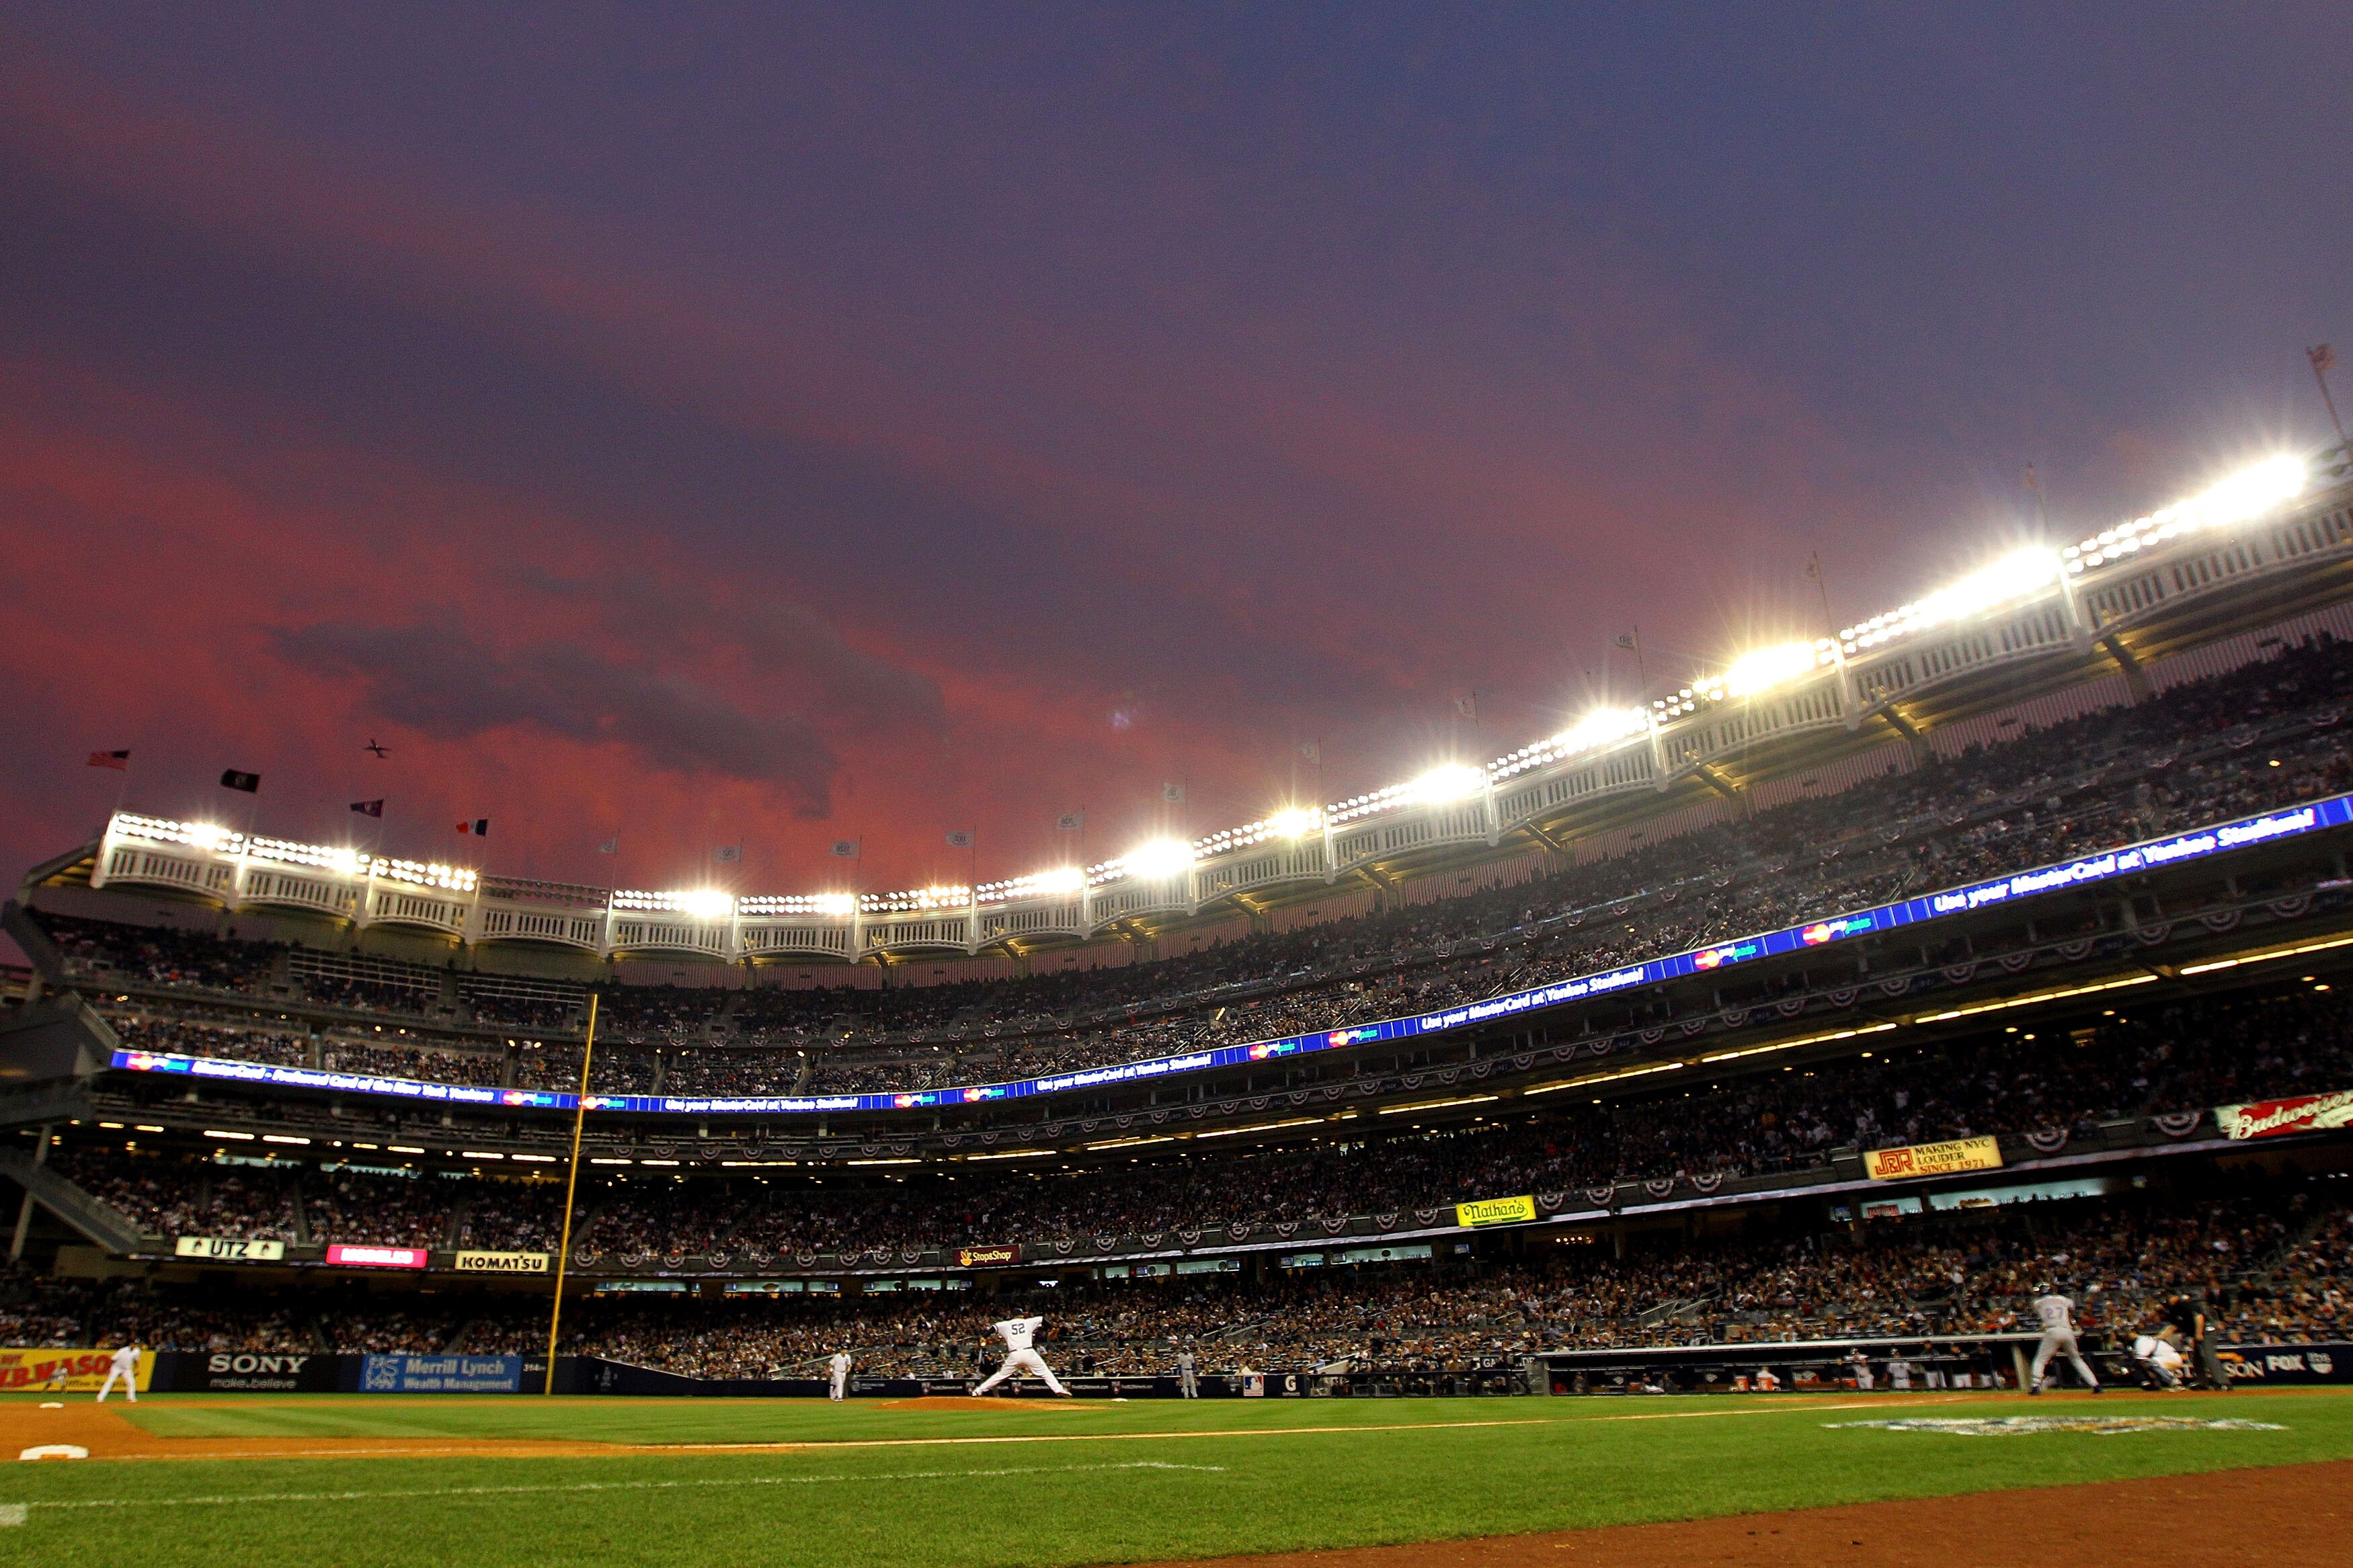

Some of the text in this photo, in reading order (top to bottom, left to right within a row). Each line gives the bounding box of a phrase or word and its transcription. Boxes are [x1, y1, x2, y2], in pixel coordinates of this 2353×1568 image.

[1933, 808, 2315, 911] Use your MasterCard at Yankee Stadium!
[1422, 967, 1644, 1030] Use your MasterCard at Yankee Stadium!
[1037, 1054, 1211, 1091] Use your MasterCard at Yankee Stadium!
[1915, 1139, 1991, 1156] MAKING NYC
[1875, 1149, 1916, 1175] J&R
[1917, 1153, 1965, 1165] LOUDER
[1919, 1163, 1956, 1174] SINCE
[1463, 1200, 1526, 1219] Nathan's
[211, 1239, 249, 1256] UTZ
[463, 1255, 542, 1270] KOMATSU
[2046, 1307, 2063, 1319] 27
[1011, 1323, 1025, 1335] 52
[208, 1354, 309, 1373] SONY
[406, 1359, 504, 1376] Merrill Lynch
[2265, 1354, 2307, 1371] FOX
[405, 1378, 512, 1391] Wealth Management
[1285, 1375, 1296, 1391] G
